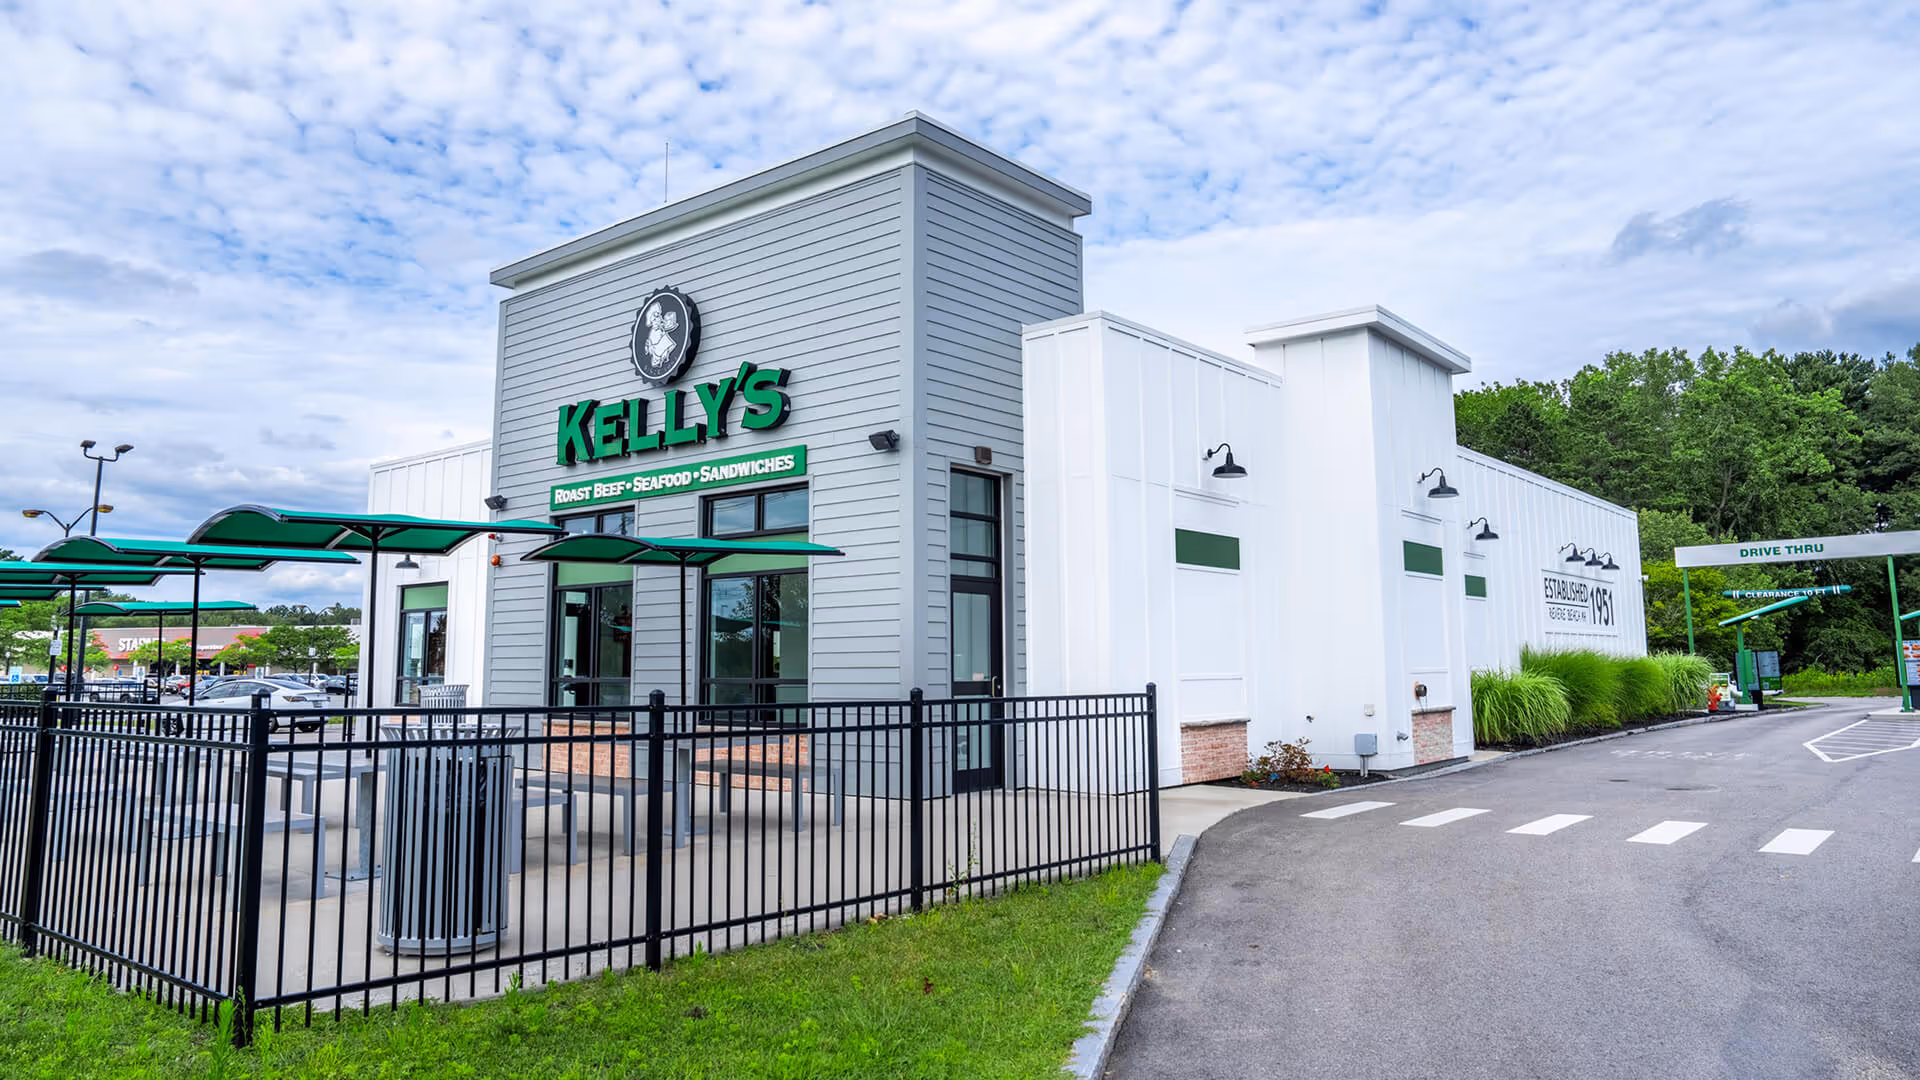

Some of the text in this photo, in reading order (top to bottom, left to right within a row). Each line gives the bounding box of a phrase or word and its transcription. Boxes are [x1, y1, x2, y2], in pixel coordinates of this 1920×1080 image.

[556, 361, 791, 466] KELLY'S
[554, 454, 796, 504] ROAST BEEF SEAFOOD SANDWICHES
[1740, 543, 1824, 558] DRIVE THRU
[1544, 577, 1615, 626] ESTABLISHED 1951
[1745, 590, 1799, 599] CLEARANCE
